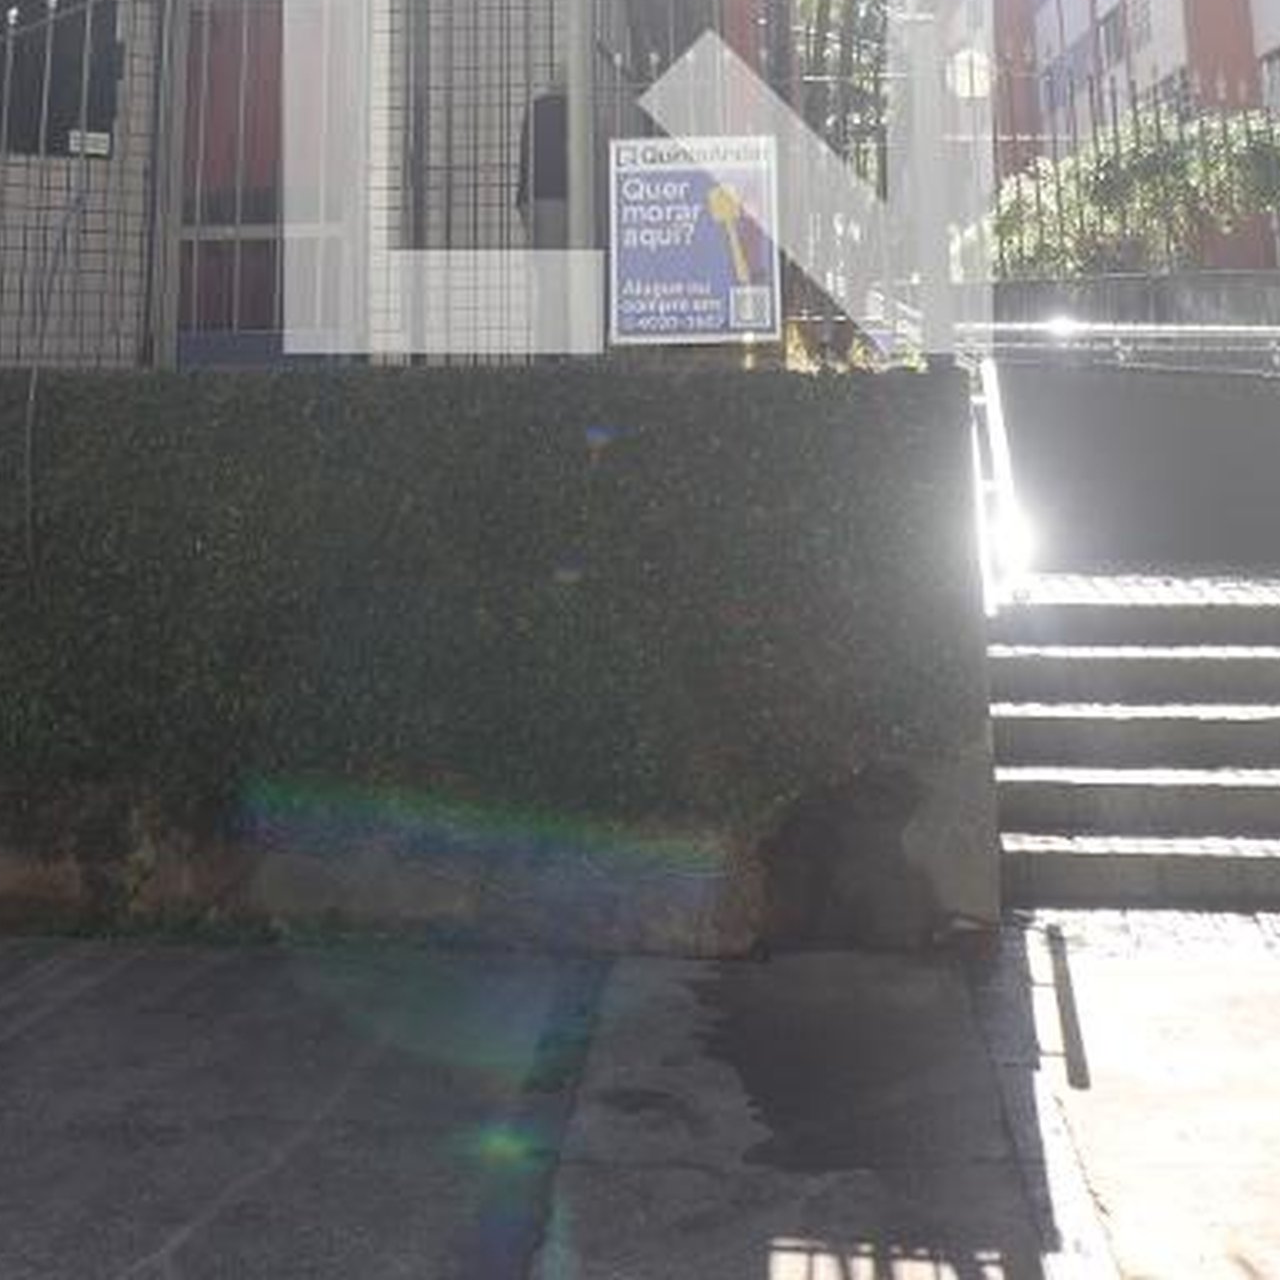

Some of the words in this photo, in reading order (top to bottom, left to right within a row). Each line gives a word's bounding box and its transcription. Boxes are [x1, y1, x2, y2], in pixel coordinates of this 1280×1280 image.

[622, 179, 690, 200] Quer
[622, 204, 700, 222] morar
[622, 224, 695, 253] aqui?
